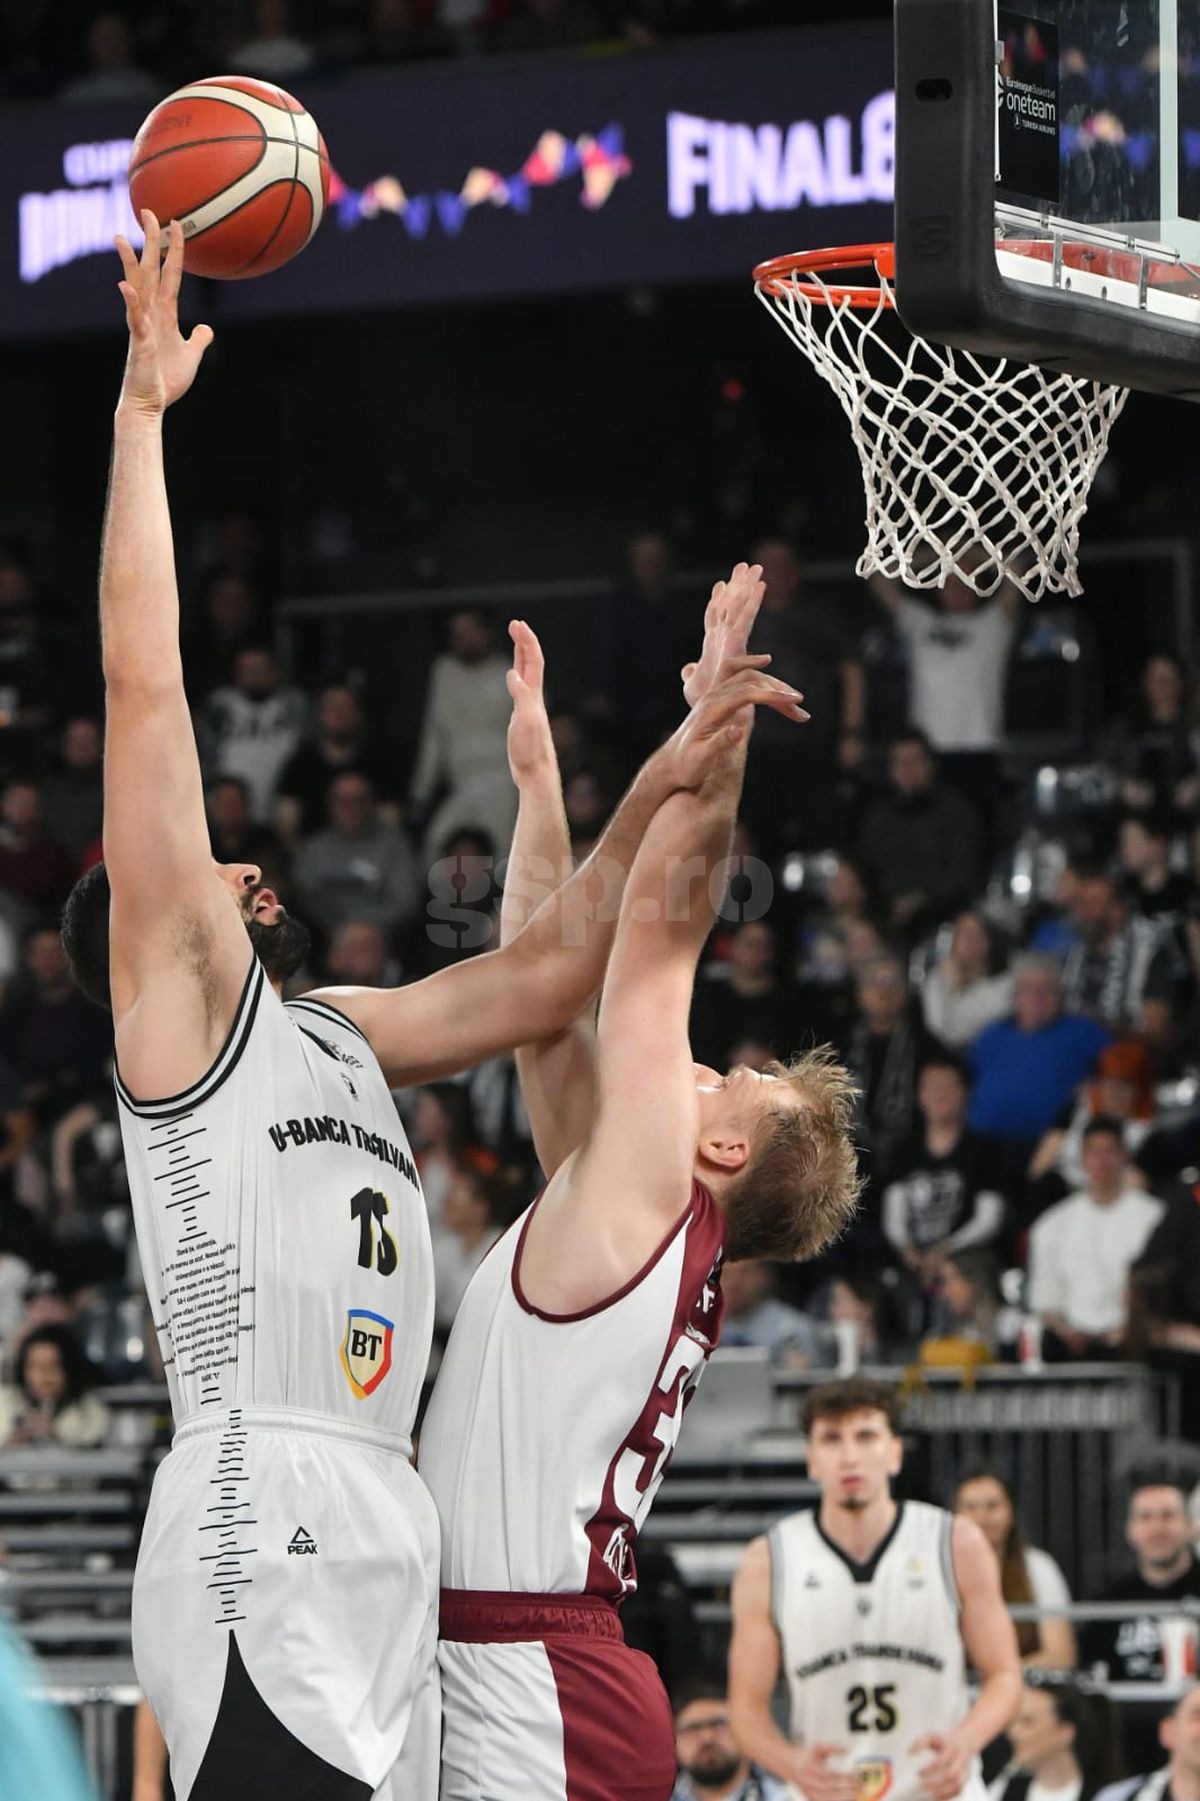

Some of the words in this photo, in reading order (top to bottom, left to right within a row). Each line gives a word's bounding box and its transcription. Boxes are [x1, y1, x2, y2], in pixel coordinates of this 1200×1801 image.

[1006, 92, 1056, 121] oneteam
[268, 1115, 351, 1152] U-BANCA
[351, 1328, 382, 1361] BT
[287, 1544, 318, 1555] PEAK
[846, 1683, 896, 1733] 25
